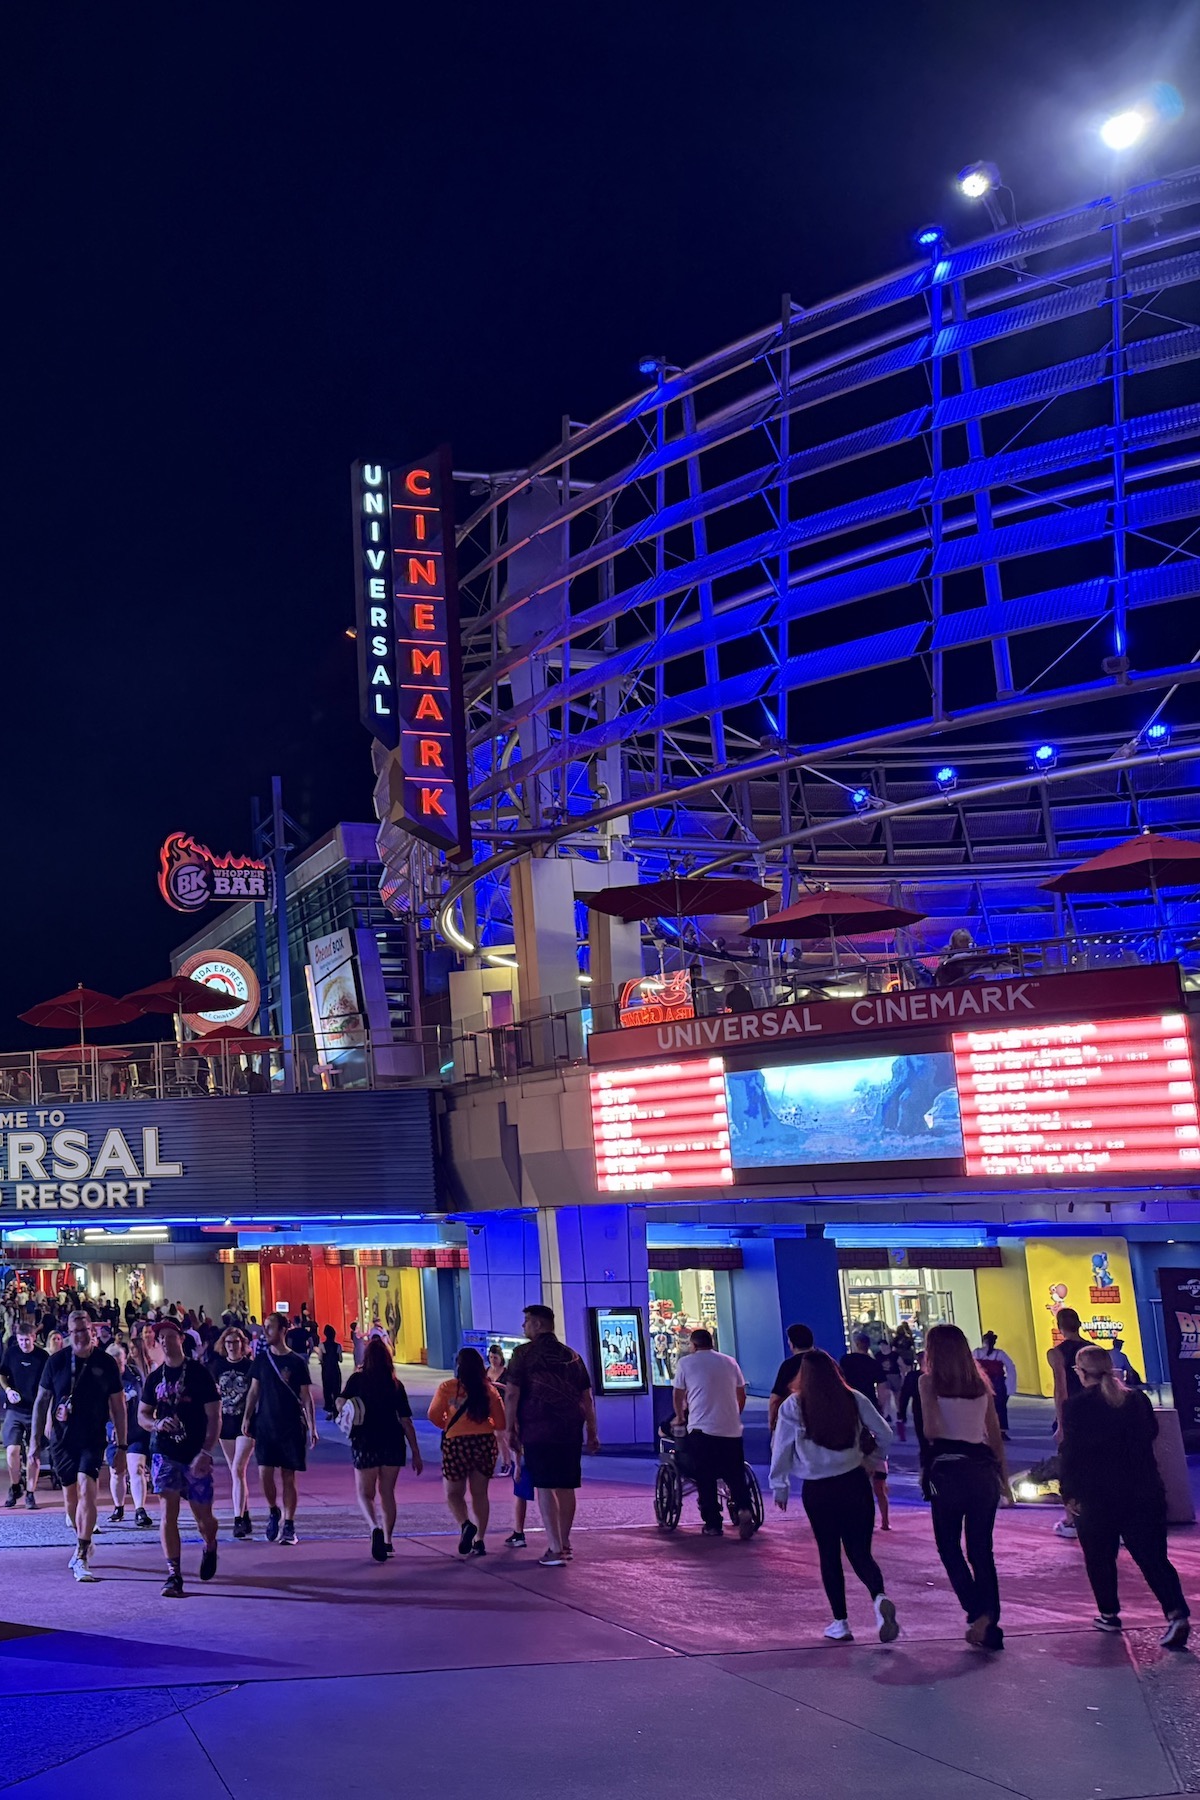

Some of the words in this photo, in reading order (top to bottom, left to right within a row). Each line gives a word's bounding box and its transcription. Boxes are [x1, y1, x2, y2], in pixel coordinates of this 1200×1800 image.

[363, 464, 391, 715] UNIVERSAL
[405, 469, 447, 816] CINEMARK
[177, 870, 208, 898] BK
[212, 868, 265, 879] WHOPPER
[213, 878, 266, 896] BAR
[194, 966, 212, 981] NDA
[214, 964, 245, 993] EXPRESS
[657, 1008, 822, 1049] UNIVERSAL
[35, 1110, 65, 1127] TO
[15, 1181, 152, 1210] RESORT
[1081, 1321, 1124, 1331] NINTENDO
[1089, 1330, 1118, 1339] WORLD
